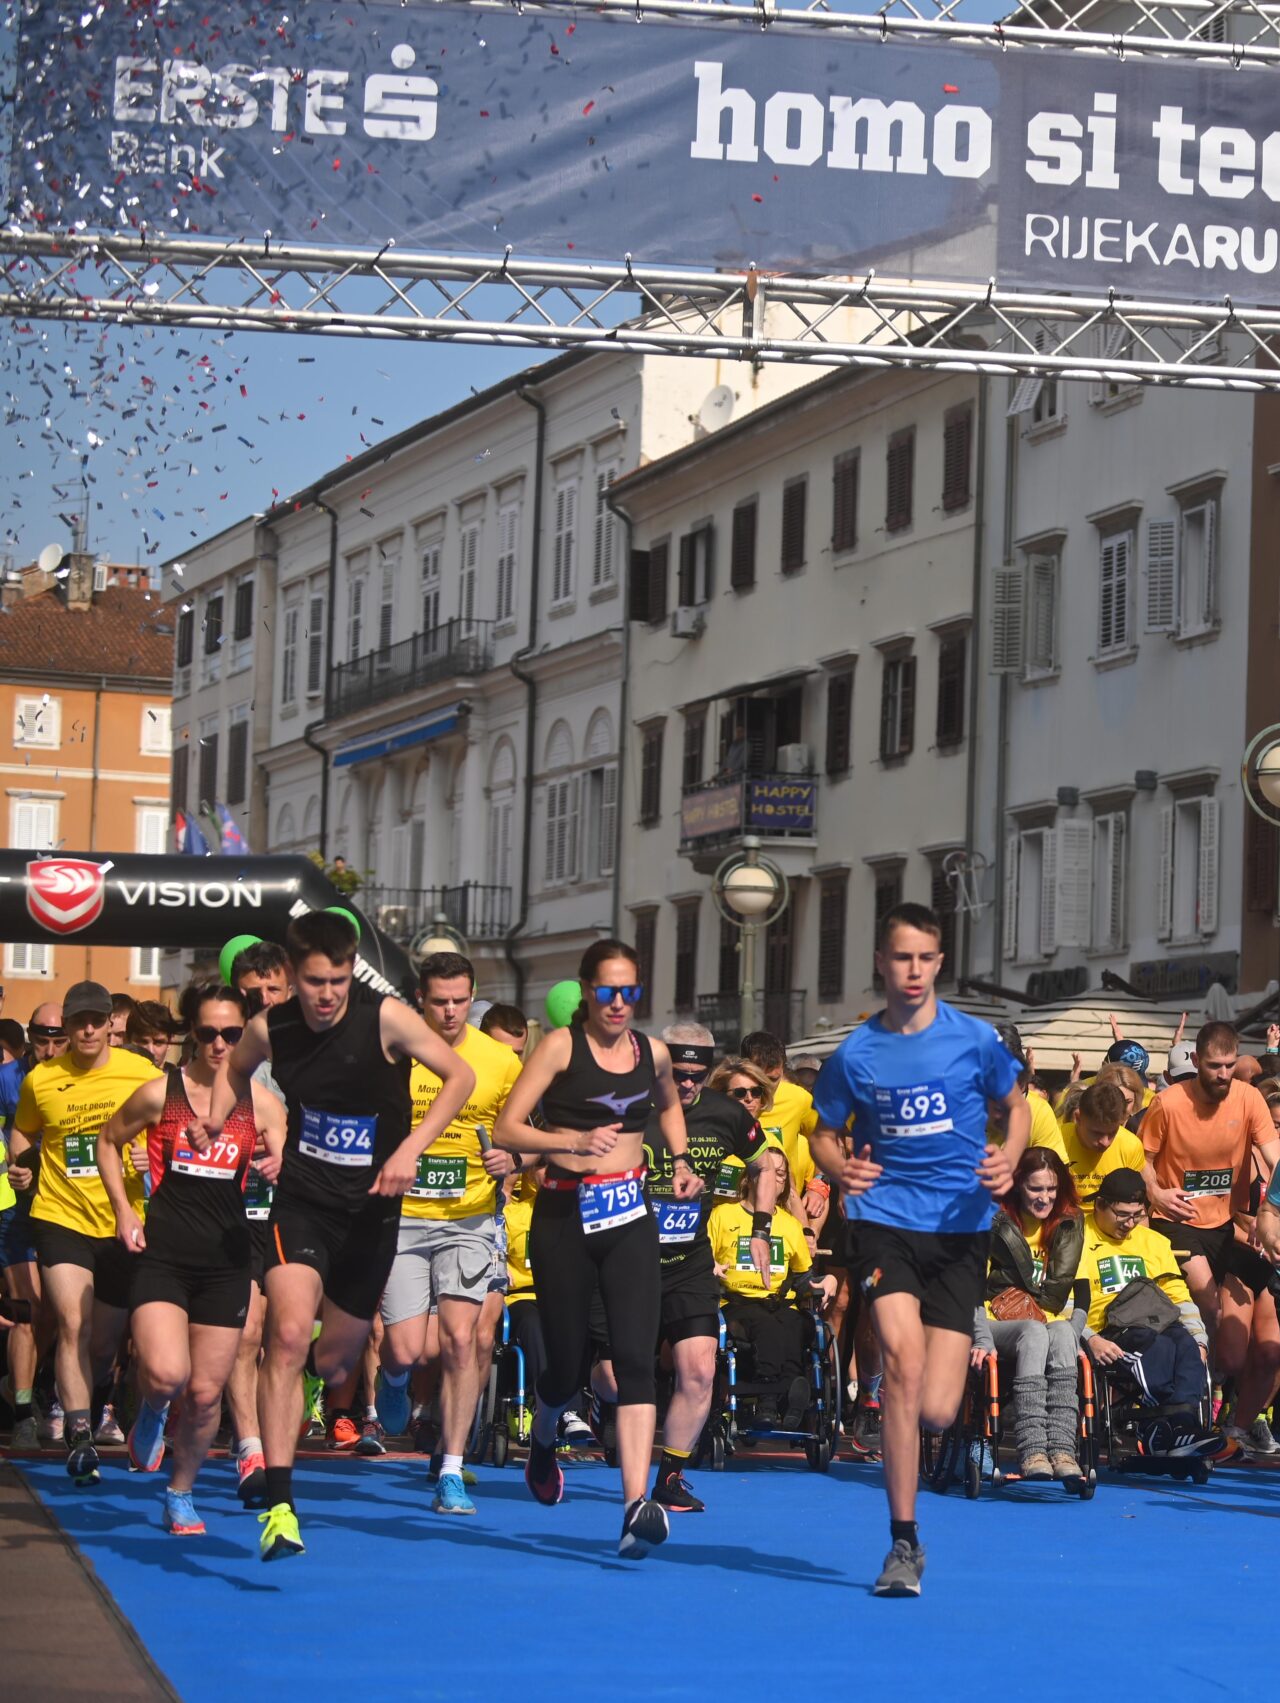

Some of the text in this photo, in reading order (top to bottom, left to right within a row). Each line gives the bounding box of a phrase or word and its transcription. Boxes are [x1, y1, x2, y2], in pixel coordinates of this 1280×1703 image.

[113, 55, 349, 136] ERSTE
[690, 61, 992, 179] homo
[1025, 93, 1120, 190] si
[109, 130, 226, 179] Bank
[754, 784, 812, 799] HAPPY
[751, 802, 815, 816] HOSTEL
[116, 880, 262, 908] VISION
[66, 1100, 116, 1113] Most people
[900, 1092, 947, 1121] 693
[325, 1126, 372, 1150] 694
[427, 1171, 455, 1185] 873
[1200, 1174, 1231, 1187] 208
[602, 1181, 639, 1212] 759
[663, 1212, 699, 1230] 647
